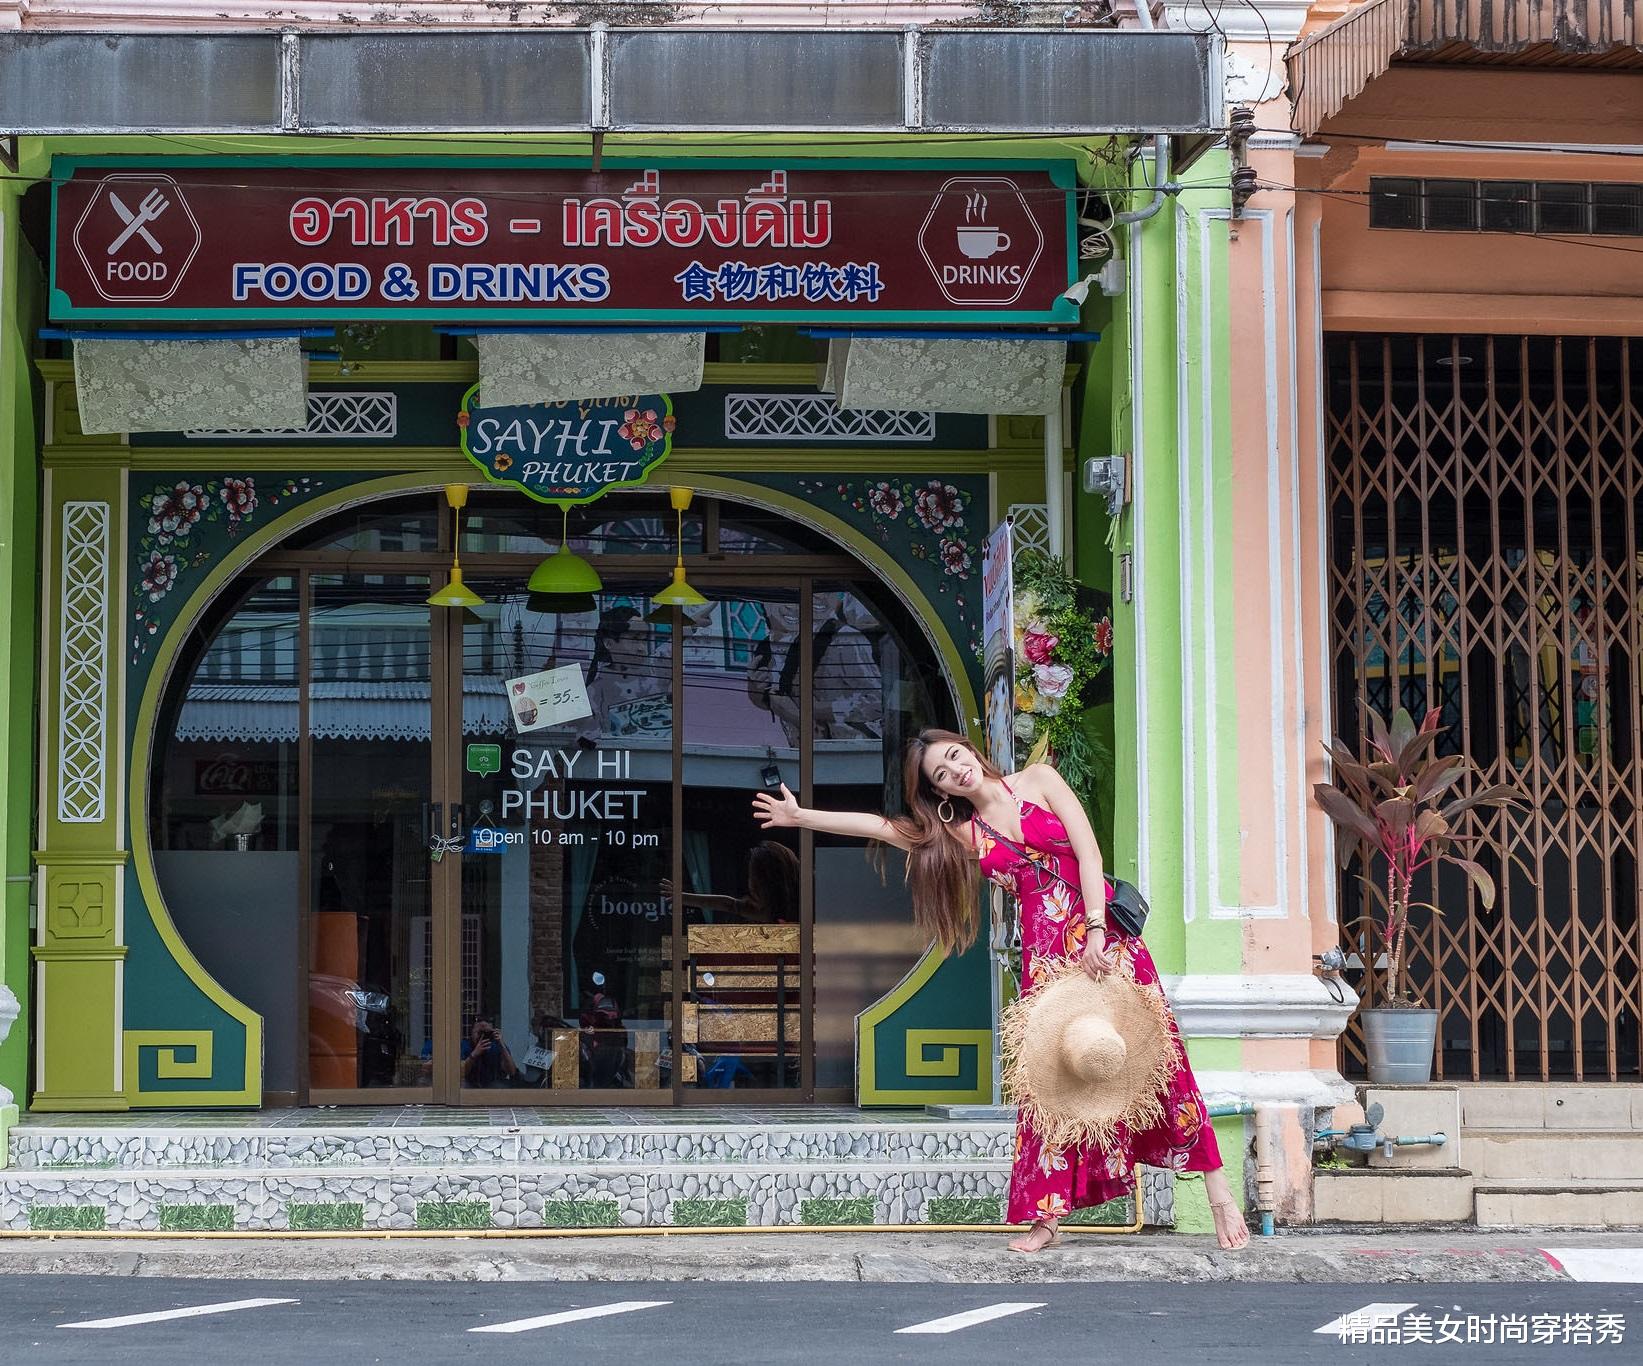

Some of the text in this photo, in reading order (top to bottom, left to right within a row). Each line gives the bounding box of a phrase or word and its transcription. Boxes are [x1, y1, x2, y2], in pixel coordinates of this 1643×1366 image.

[290, 197, 489, 247] อาหาร
[563, 170, 833, 248] เครื่องดื่ม
[106, 261, 168, 281] FOOD
[233, 263, 611, 302] FOOD & DRINKS
[674, 261, 885, 303] 食物和饮料
[942, 264, 1022, 286] DRINKS
[522, 461, 639, 484] PHUKET
[511, 749, 630, 779] SAY HI
[502, 790, 647, 820] PHUKET
[479, 828, 524, 848] Open
[532, 829, 552, 844] 10
[558, 832, 584, 845] am
[605, 830, 626, 846] 10
[632, 833, 659, 848] pm
